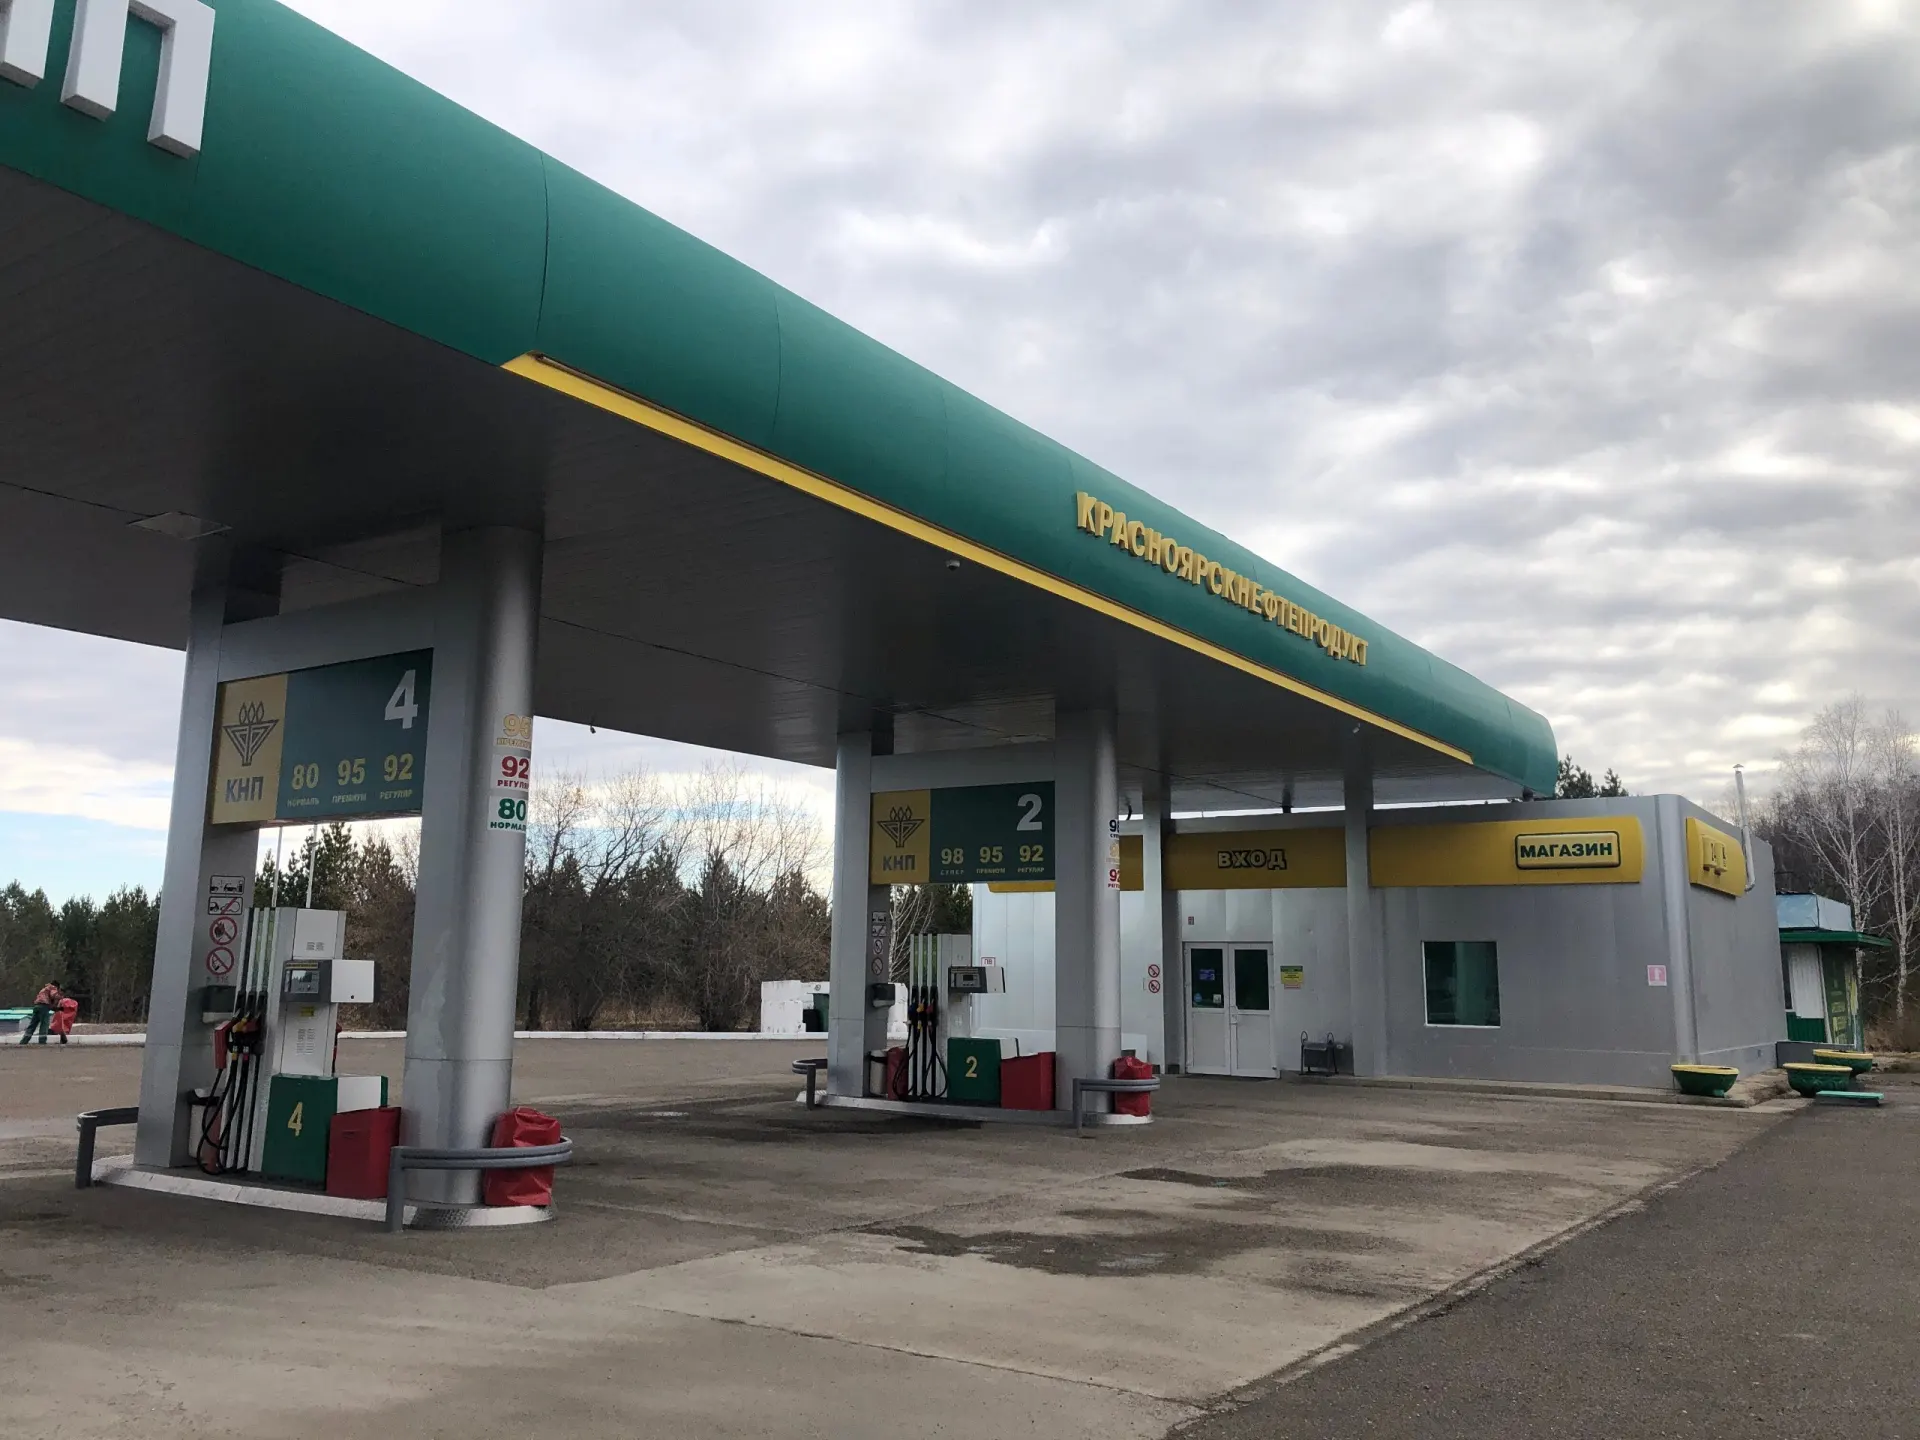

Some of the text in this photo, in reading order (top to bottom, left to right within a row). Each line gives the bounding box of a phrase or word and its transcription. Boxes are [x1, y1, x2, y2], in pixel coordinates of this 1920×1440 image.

[1076, 491, 1369, 666] КРАСНОЯРСКНЕФТЕПРОДУКТ
[384, 669, 419, 729] 4
[291, 753, 414, 790] 80 95 92
[501, 755, 530, 779] 92
[225, 776, 264, 803] КНП
[497, 798, 526, 821] 80
[1016, 793, 1043, 831] 2
[941, 844, 1044, 865] 98 95 92
[1217, 848, 1288, 870] ВХОД
[1520, 842, 1613, 858] МАГАЗИН
[882, 854, 916, 871] КНП
[965, 1055, 978, 1078] 2
[287, 1101, 304, 1137] 4
